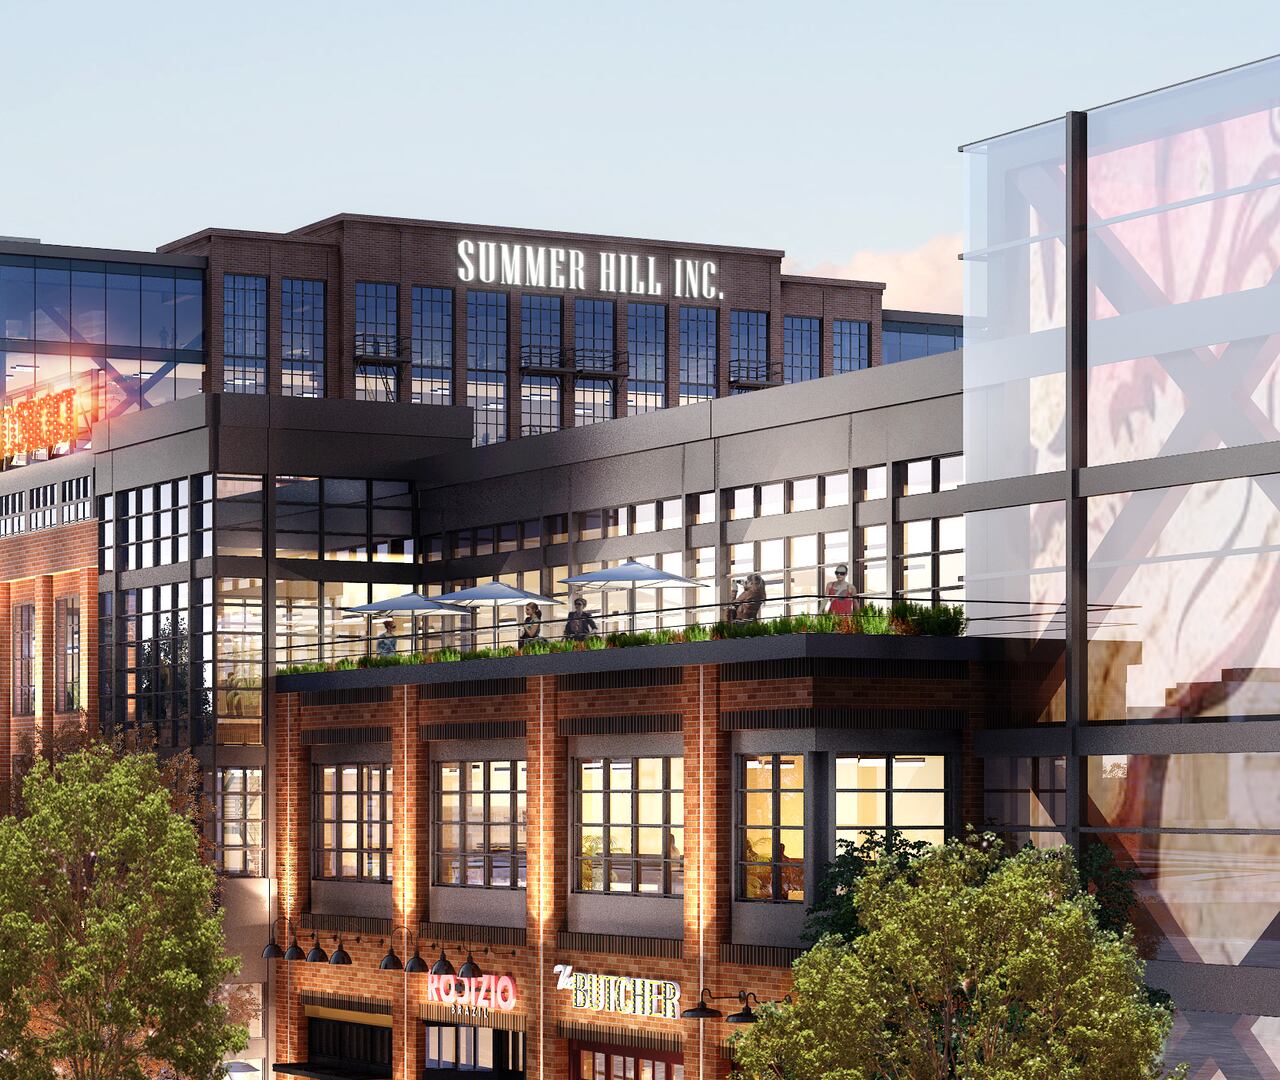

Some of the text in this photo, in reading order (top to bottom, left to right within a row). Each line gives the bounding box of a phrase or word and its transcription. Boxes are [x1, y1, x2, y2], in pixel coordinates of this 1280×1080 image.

[457, 239, 724, 300] SUMMER HILL INC.
[451, 1003, 489, 1019] BRAZIL
[571, 971, 682, 1020] BUTCHER
